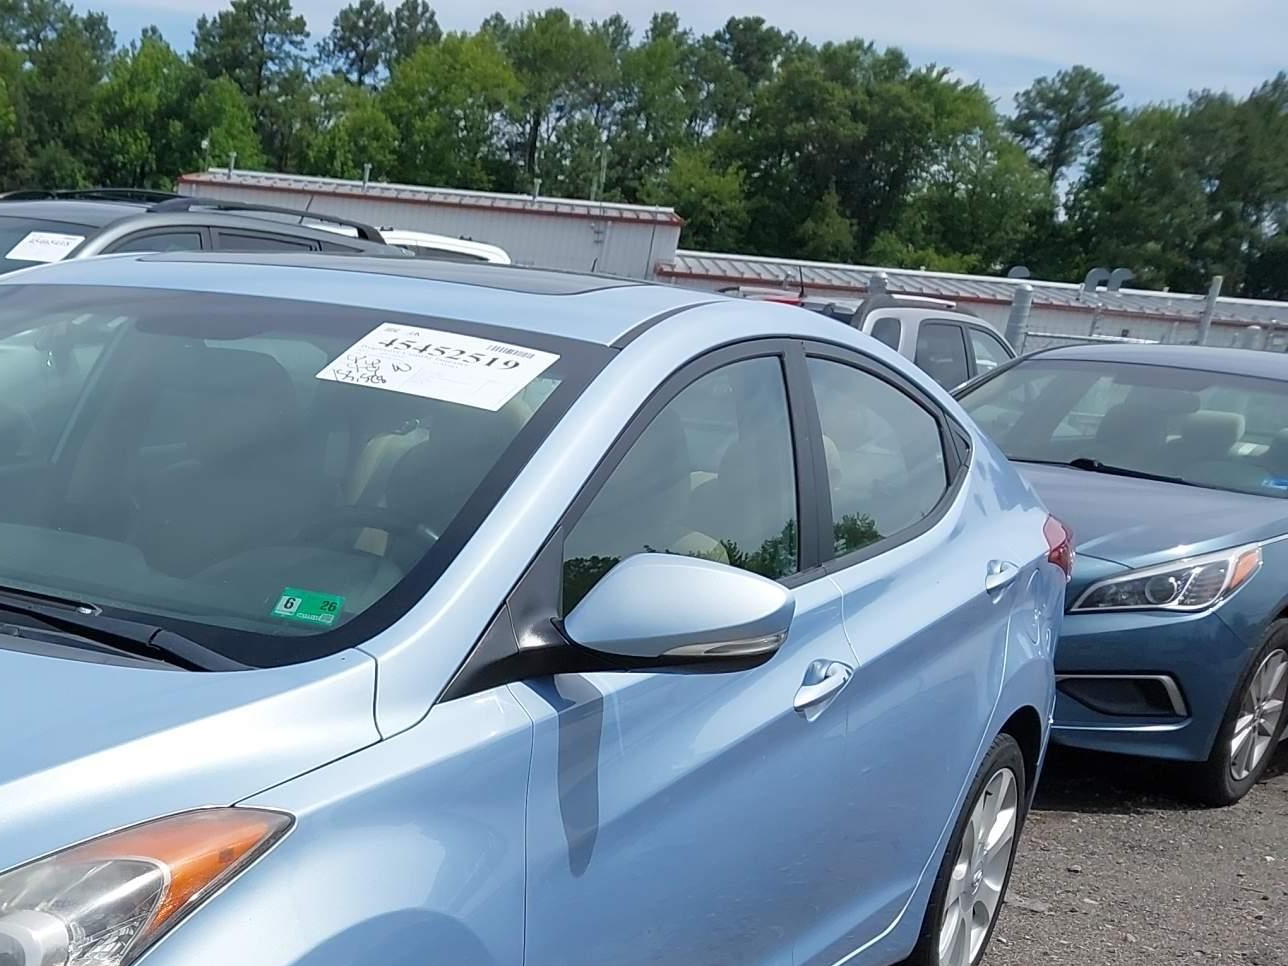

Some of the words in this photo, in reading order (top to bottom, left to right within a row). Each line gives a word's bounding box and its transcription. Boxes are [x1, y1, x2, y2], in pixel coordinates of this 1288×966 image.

[379, 338, 520, 370] 45452519
[284, 597, 296, 609] 6
[320, 601, 337, 611] 26
